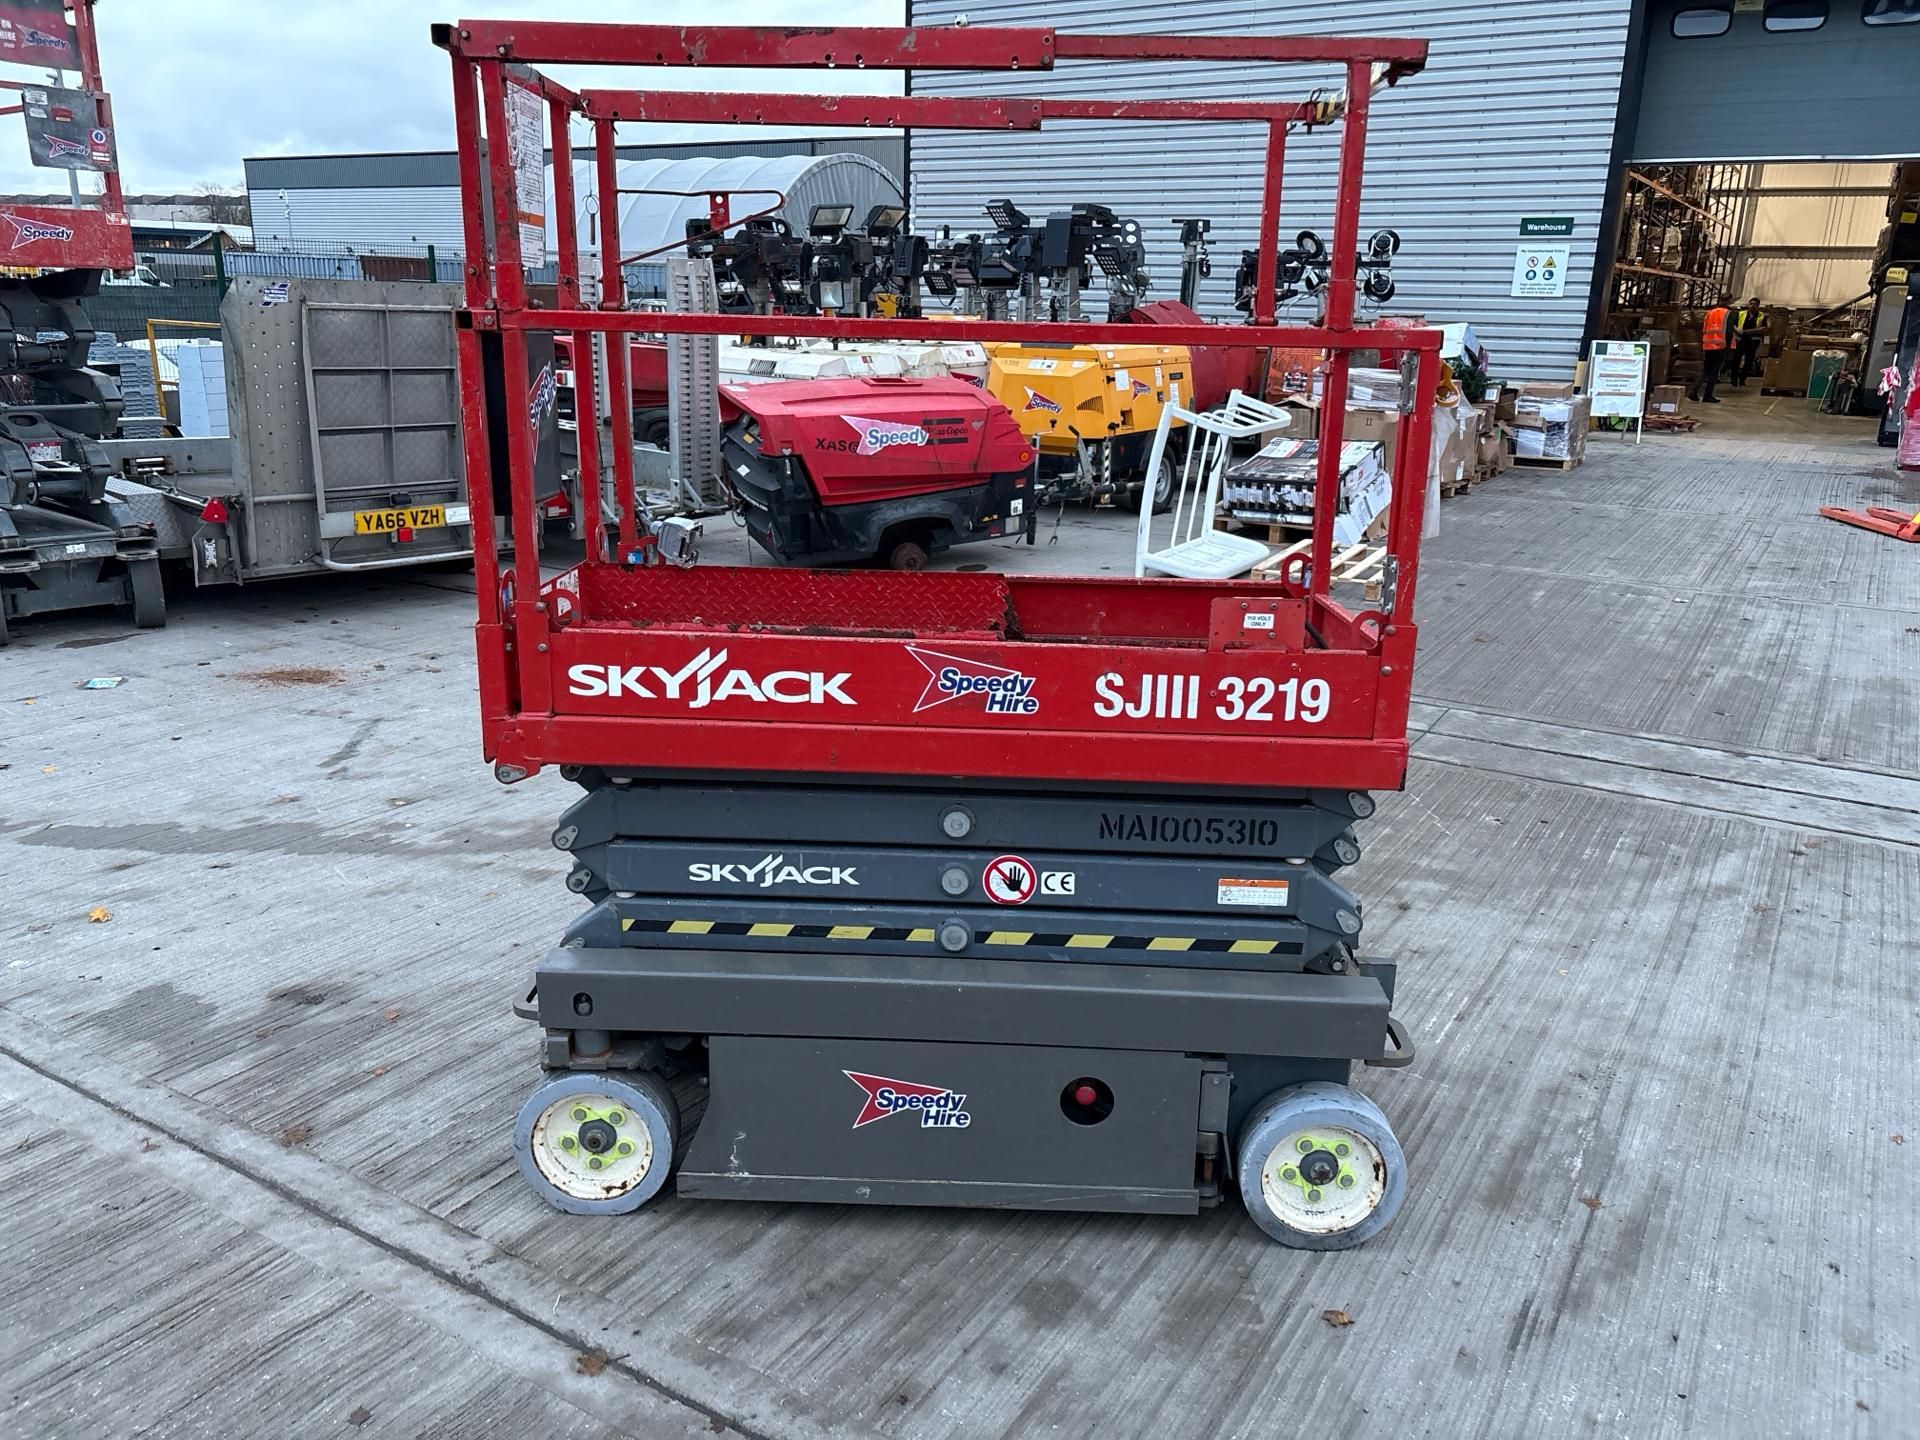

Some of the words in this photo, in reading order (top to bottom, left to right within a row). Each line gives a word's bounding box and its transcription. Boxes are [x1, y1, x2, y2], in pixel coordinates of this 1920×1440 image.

[27, 31, 68, 50] Speedy
[56, 143, 90, 156] Speedy
[23, 225, 73, 240] Speedy
[1031, 397, 1061, 414] Speedy
[867, 427, 929, 447] Speedy
[363, 512, 406, 531] YA66
[410, 508, 439, 527] VZH
[567, 646, 859, 709] SKYJACK
[939, 667, 1034, 696] Speedy
[988, 692, 1038, 713] Hire
[1093, 672, 1200, 720] SJIII
[1215, 676, 1331, 723] 3219
[1099, 813, 1278, 846] MA1005310
[688, 853, 860, 888] SKYJACK
[1043, 872, 1074, 893] CE
[877, 1088, 966, 1112] Speedy
[921, 1109, 970, 1127] Hire
